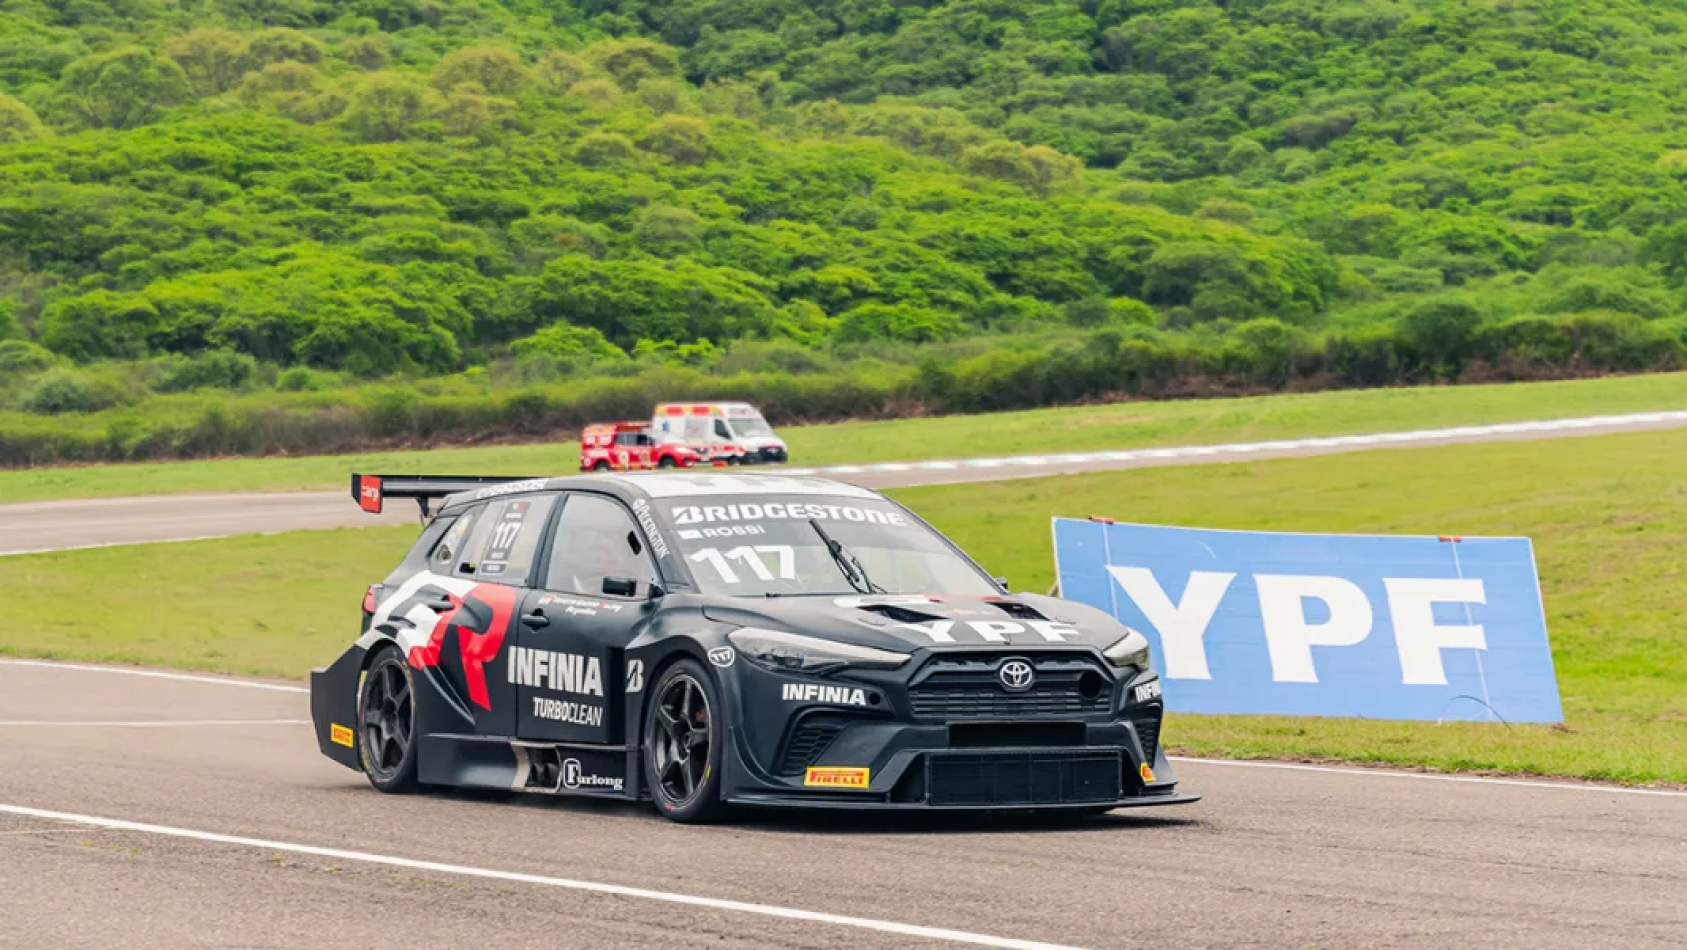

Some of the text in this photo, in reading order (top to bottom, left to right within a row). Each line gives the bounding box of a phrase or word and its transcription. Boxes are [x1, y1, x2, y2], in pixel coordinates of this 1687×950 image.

[671, 503, 906, 526] BRIDGESTONE
[492, 522, 521, 549] 117
[702, 525, 765, 538] ROSSI
[691, 545, 795, 583] 117
[897, 620, 1080, 642] YPF
[1106, 565, 1487, 685] YPF
[711, 650, 730, 662] 117
[508, 646, 603, 697] INFINIA
[782, 683, 866, 706] INFINIA
[533, 697, 603, 728] TURBOCLEAN
[562, 759, 623, 789] Furlong
[809, 770, 864, 785] PIRELLI
